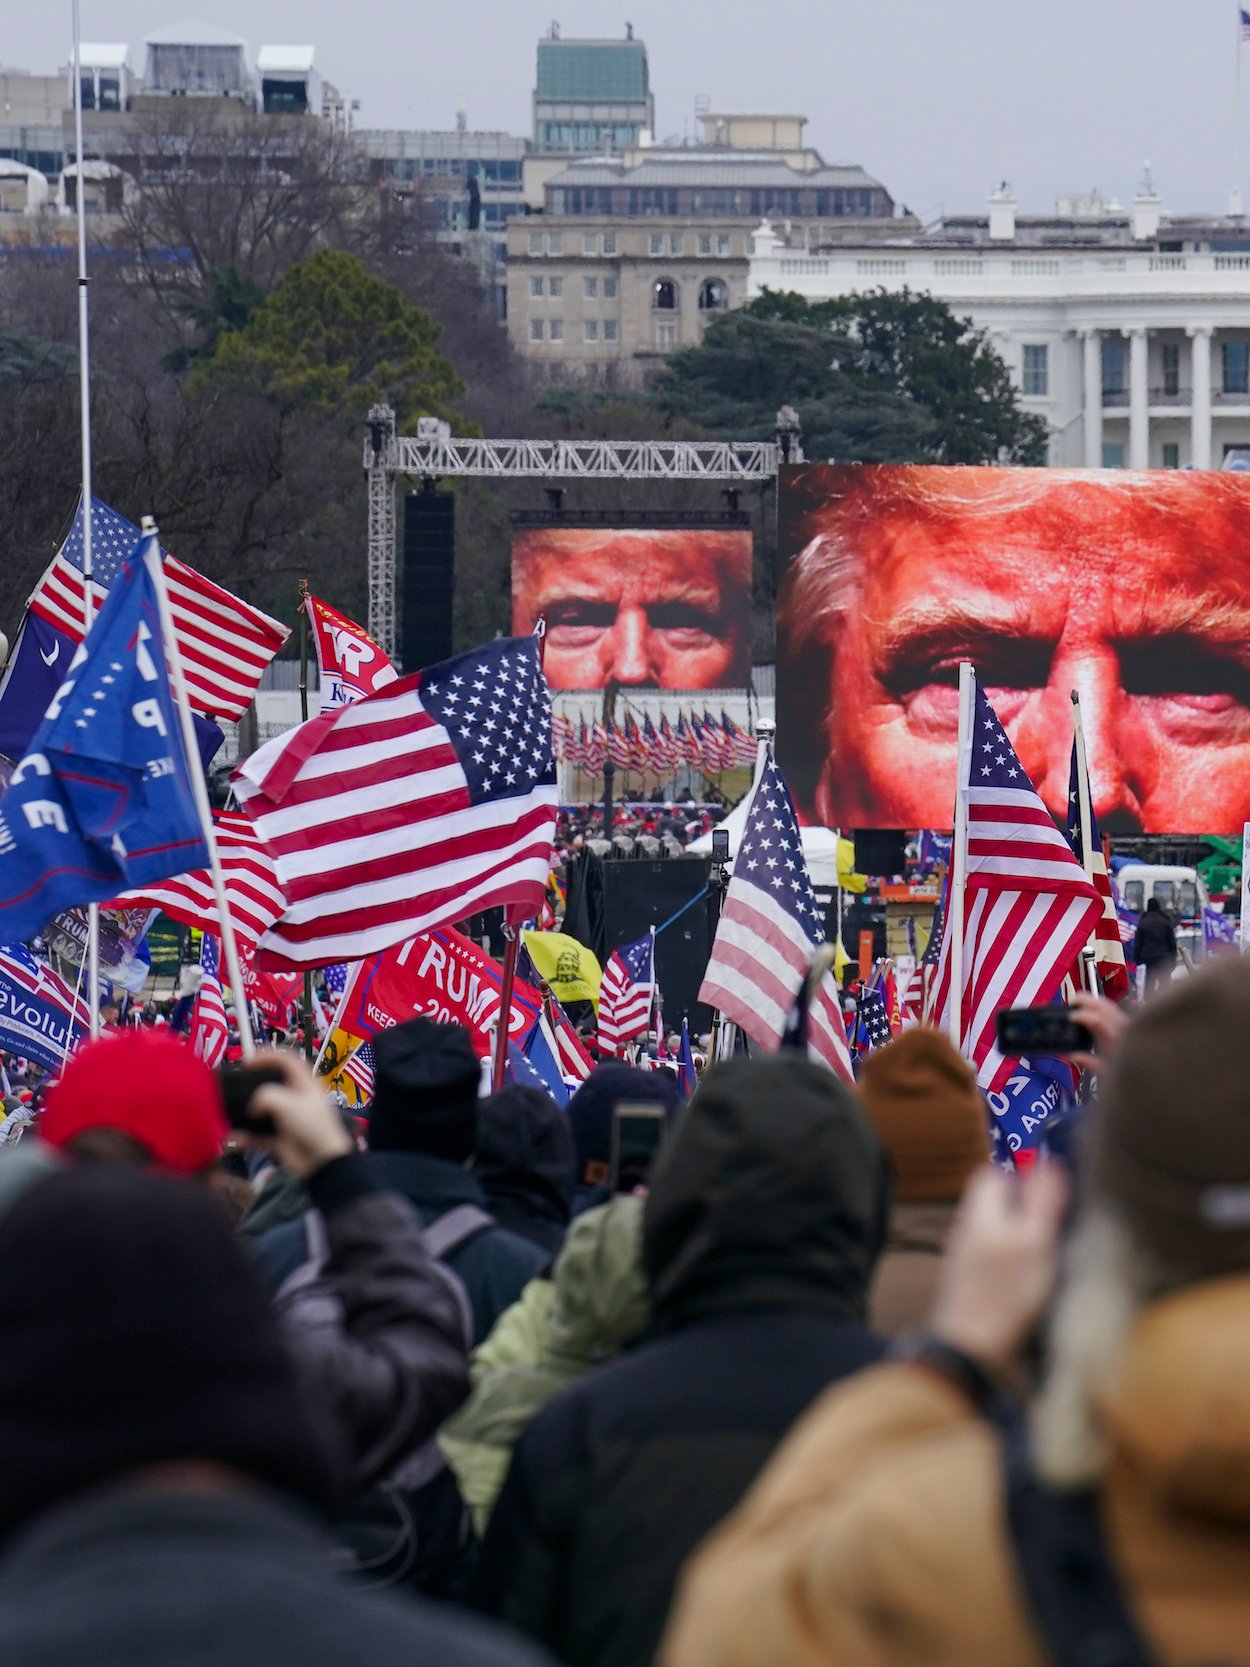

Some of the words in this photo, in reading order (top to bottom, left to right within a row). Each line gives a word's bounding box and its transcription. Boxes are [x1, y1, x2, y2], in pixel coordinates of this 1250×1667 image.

[55, 913, 90, 945] TRUM
[396, 932, 525, 1034] TRUMP
[0, 990, 84, 1054] evoluti
[367, 1003, 397, 1029] KEEP
